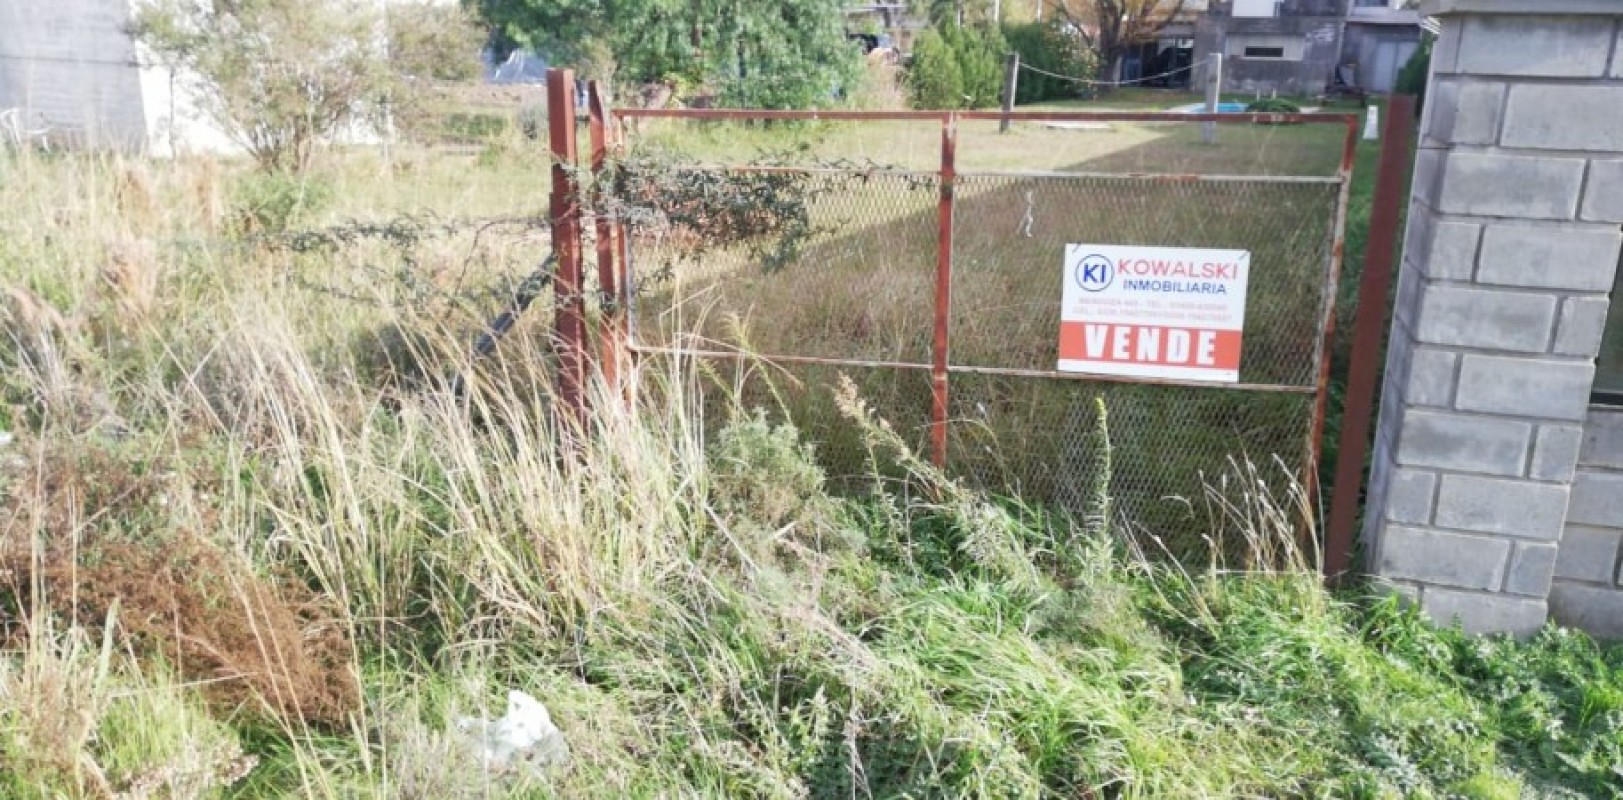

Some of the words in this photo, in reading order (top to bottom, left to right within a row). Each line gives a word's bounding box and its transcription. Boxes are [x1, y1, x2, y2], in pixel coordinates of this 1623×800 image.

[1083, 263, 1107, 283] KI
[1117, 259, 1238, 279] KOWALSKI
[1123, 279, 1227, 294] INMOBILIARIA
[1084, 323, 1217, 366] VENDE
